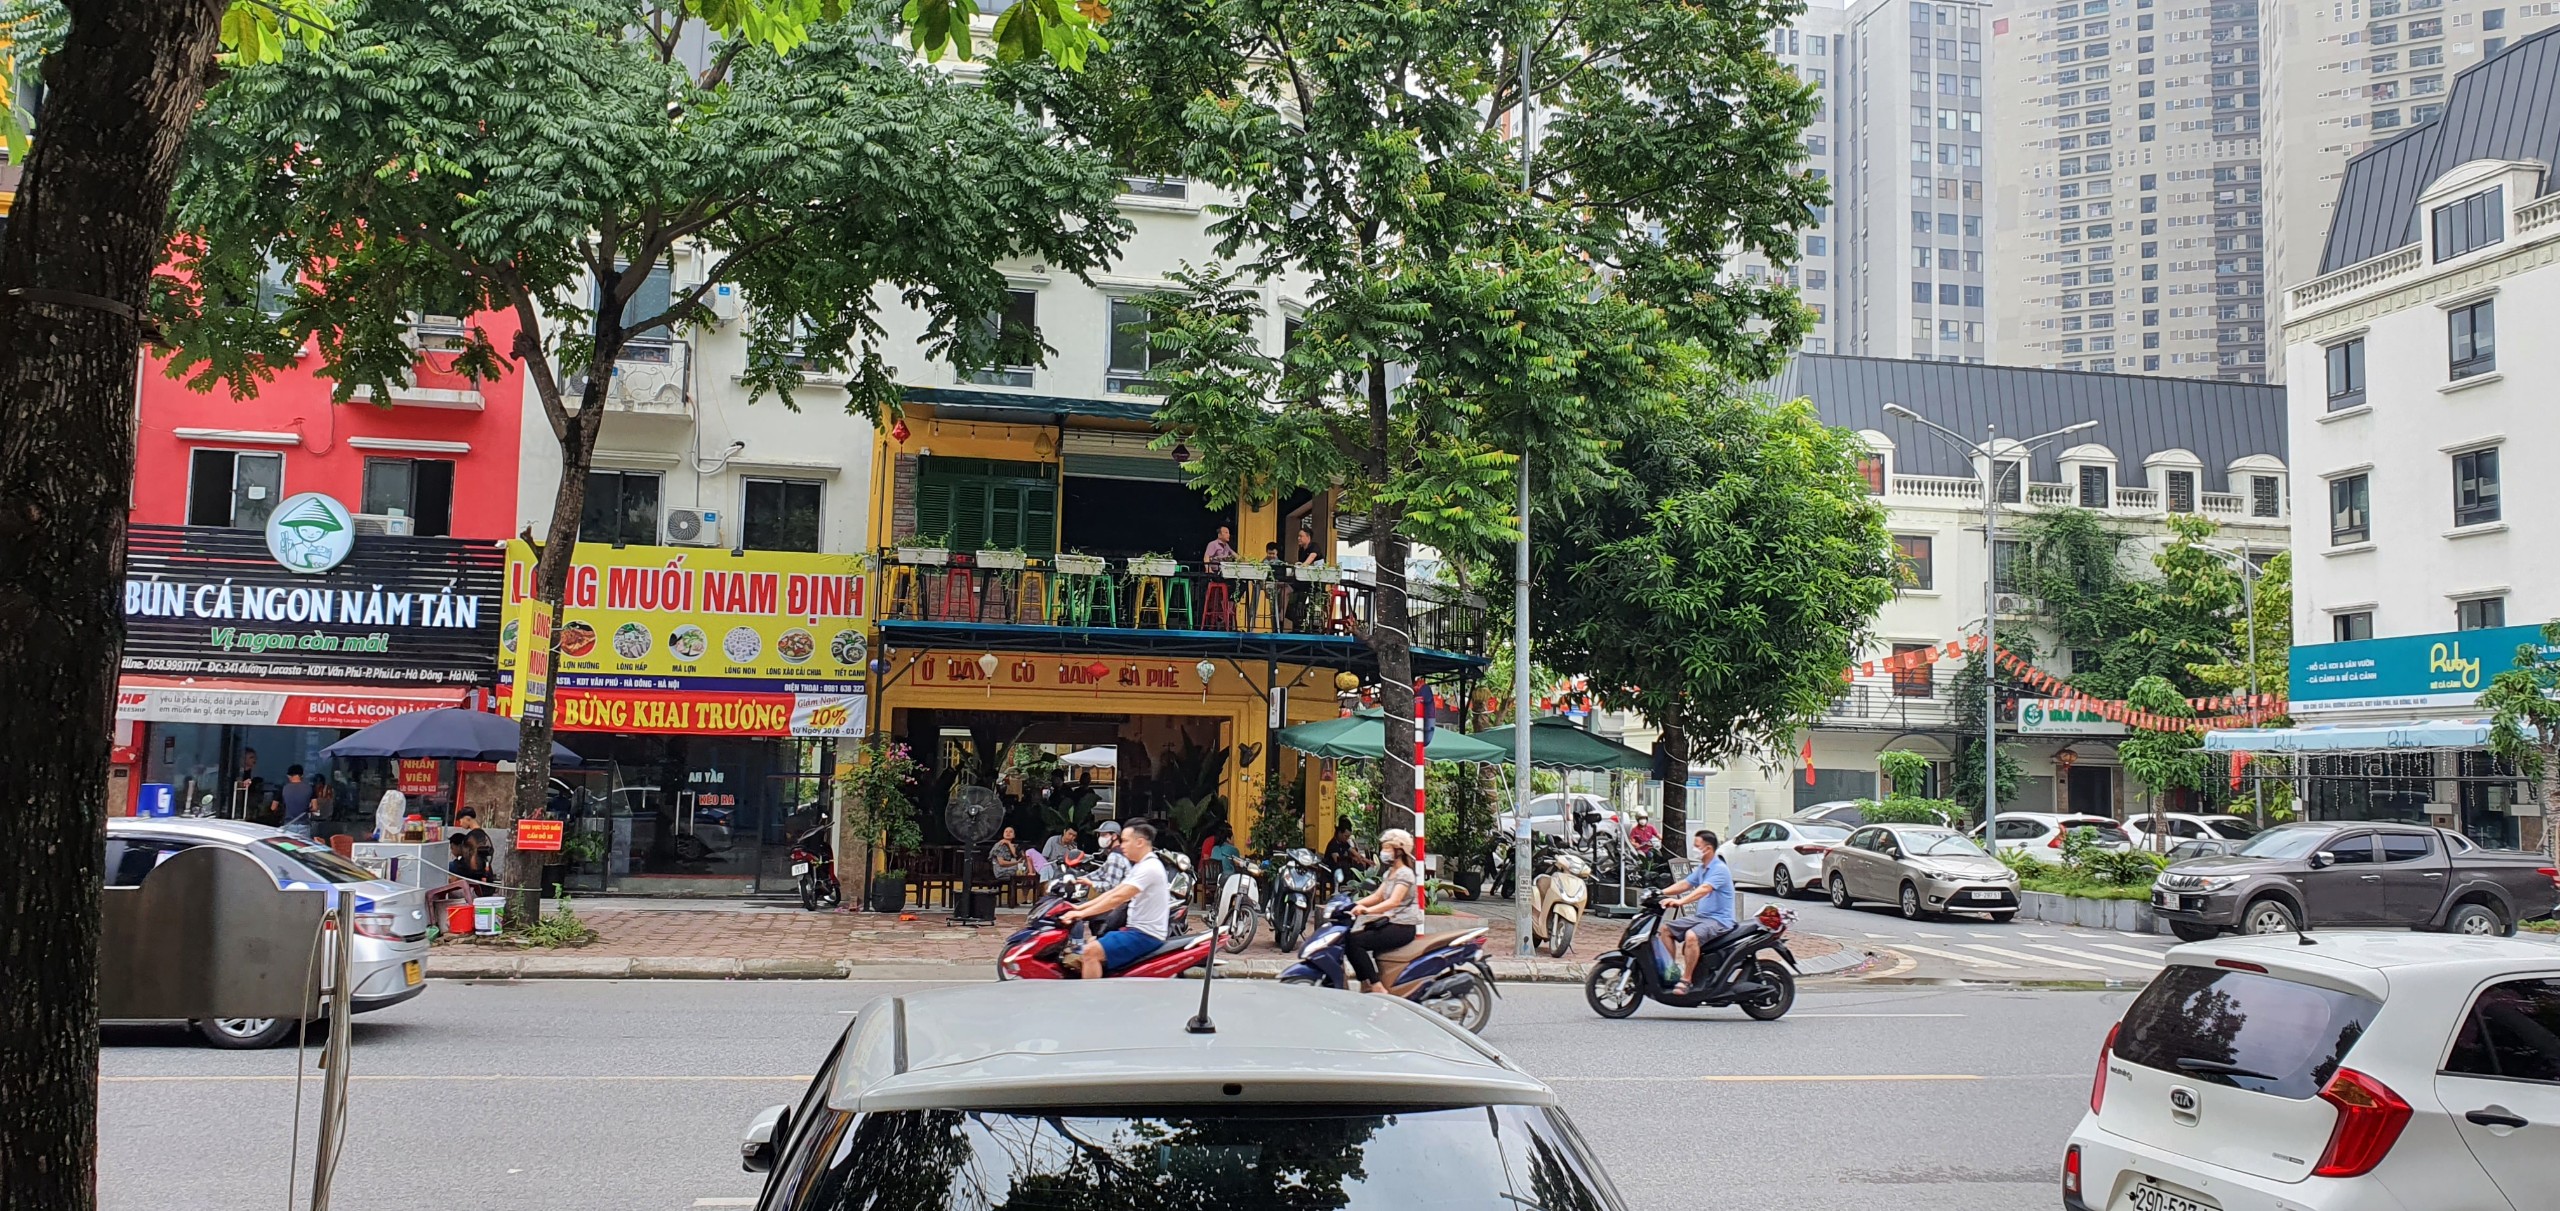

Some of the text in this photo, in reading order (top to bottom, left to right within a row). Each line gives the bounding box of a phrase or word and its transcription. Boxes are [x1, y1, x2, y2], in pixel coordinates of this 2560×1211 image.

[126, 574, 186, 617] BÚN
[193, 578, 235, 618] CÁ
[241, 586, 333, 622] NGON
[339, 584, 412, 626] NĂM
[512, 555, 864, 625] LG MUỐI NAM ĐỊNH
[211, 627, 390, 653] Vị ngon còn mãi
[307, 665, 326, 677] KĐT
[419, 670, 443, 683] Đông
[743, 667, 757, 675] NON
[921, 656, 935, 681] Ở
[1010, 660, 1036, 683] CÓ
[2430, 641, 2480, 688] Ruby
[309, 700, 335, 714] BÚN
[337, 701, 355, 715] CÁ
[357, 704, 395, 716] NGON
[564, 691, 786, 731] BỪNG KHAI TRƯƠNG
[809, 708, 847, 728] 10%
[405, 771, 432, 783] VIÊN
[720, 794, 735, 806] RA
[2173, 1093, 2191, 1107] KIA
